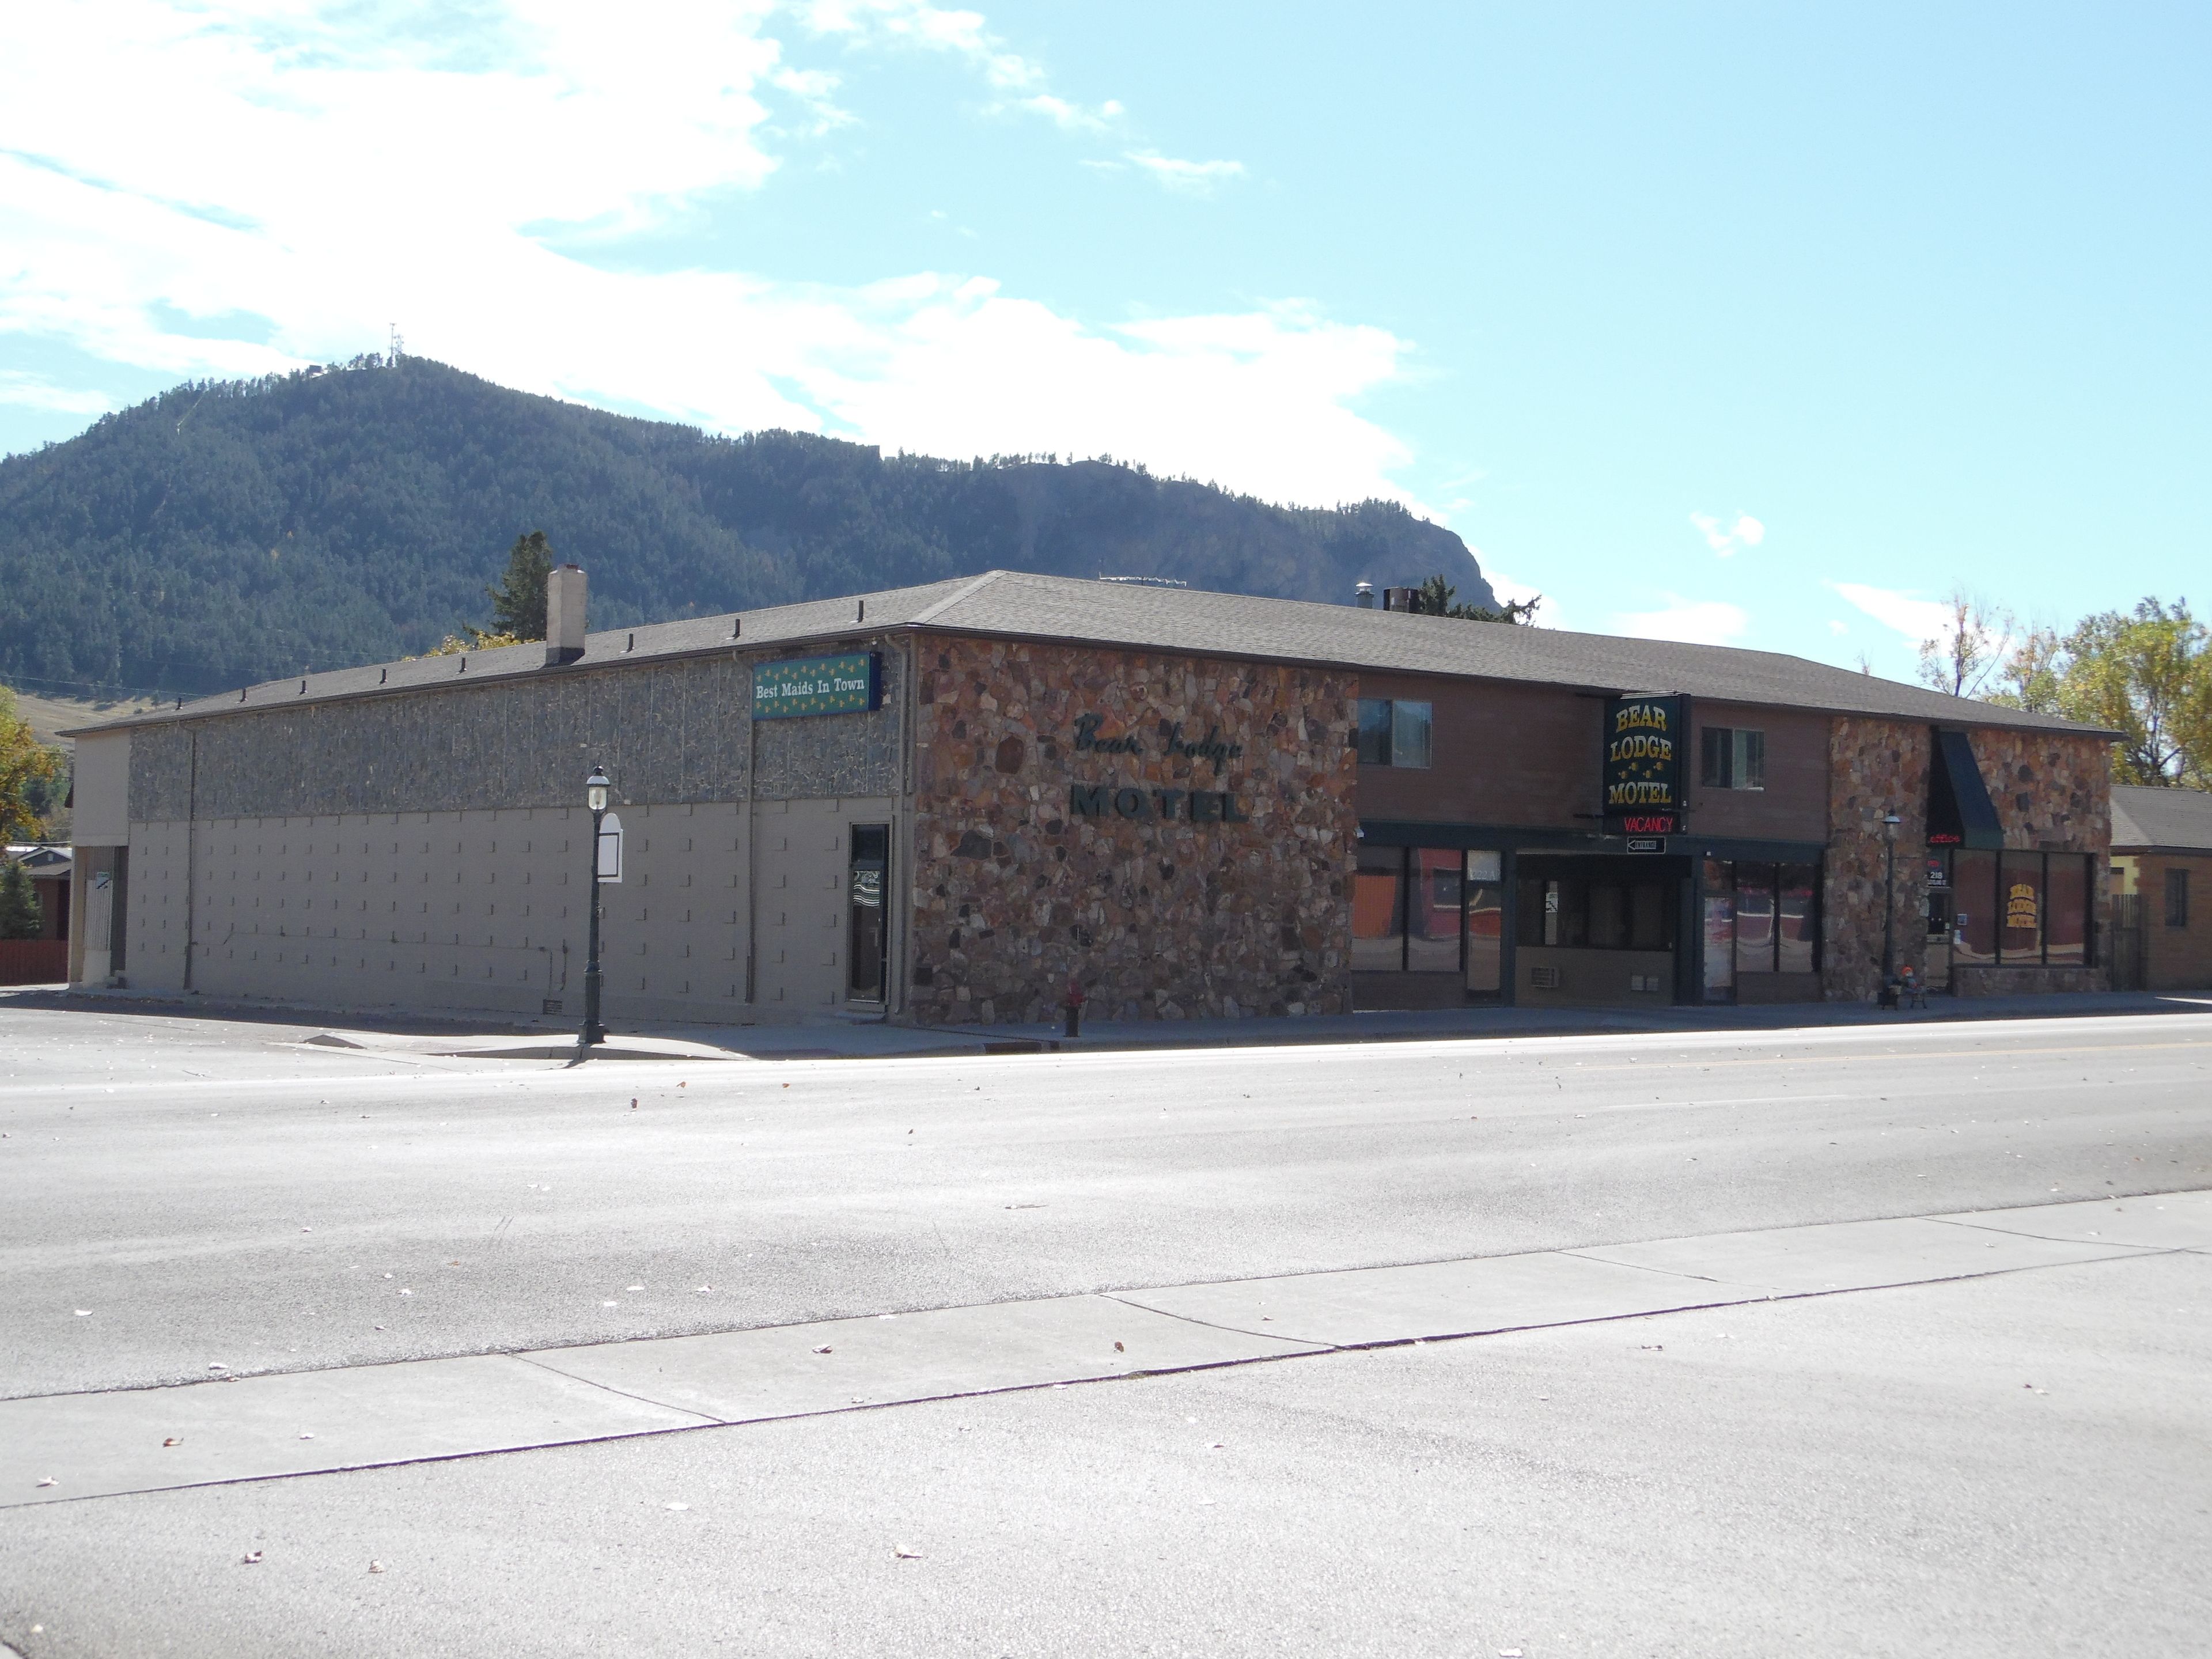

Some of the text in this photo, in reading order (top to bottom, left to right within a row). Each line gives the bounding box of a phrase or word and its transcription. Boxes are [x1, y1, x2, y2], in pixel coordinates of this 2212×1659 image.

[756, 677, 865, 699] Best Maids In Town
[1615, 704, 1667, 733] BEAR
[1610, 735, 1672, 762] LODGE
[1070, 784, 1249, 822] MOTEL
[1608, 781, 1671, 804] MOTEL
[1624, 817, 1673, 832] VACANCY
[1930, 871, 1943, 879] 218
